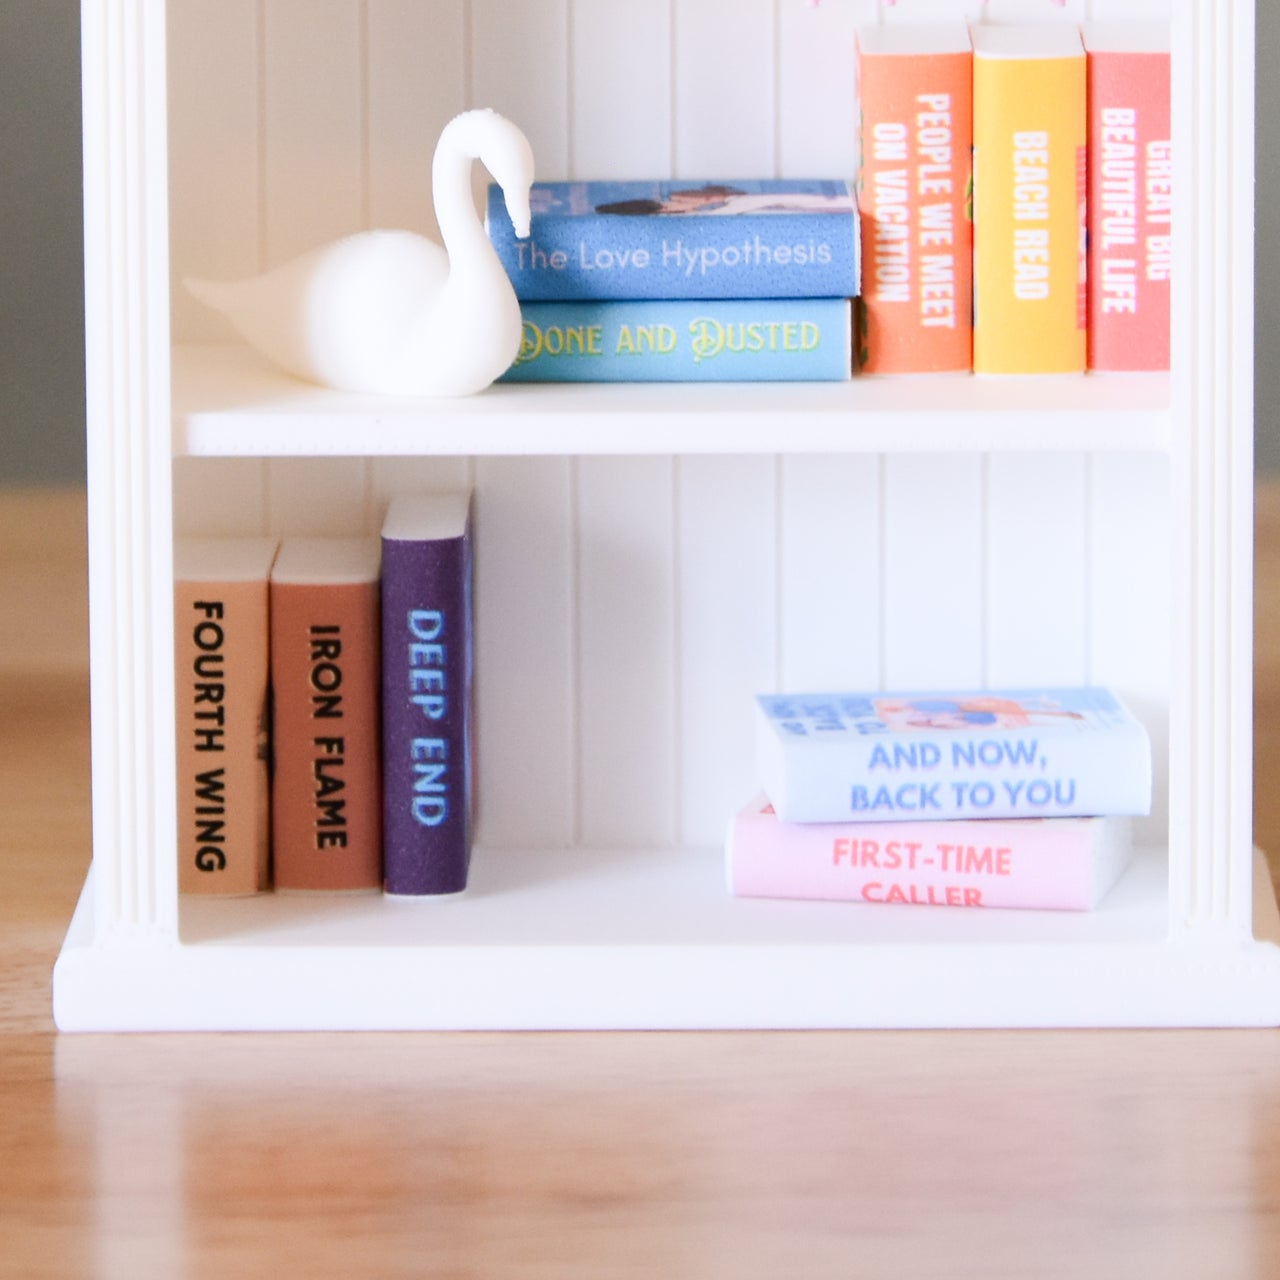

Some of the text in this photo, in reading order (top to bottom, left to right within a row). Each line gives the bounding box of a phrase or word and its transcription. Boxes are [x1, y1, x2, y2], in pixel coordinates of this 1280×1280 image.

[514, 238, 832, 276] The Love Hypothesis
[873, 122, 910, 302] ON VACATION
[916, 93, 956, 328] PEOPLE WE MEET
[1013, 131, 1050, 300] BEACH READ
[1101, 108, 1137, 313] BEAUTIFUL LIFE
[1146, 140, 1171, 280] GREAT BIG
[616, 324, 677, 355] AND
[689, 317, 820, 365] DUSTED
[193, 601, 226, 872] FOURTH WING
[310, 625, 347, 850] IRON FLAME
[408, 609, 448, 826] DEEP END
[868, 739, 1047, 770] AND NOW,
[833, 838, 1012, 877] FIRST-TIME
[850, 779, 1076, 812] BACK TO YOU
[860, 881, 984, 907] CALLER
